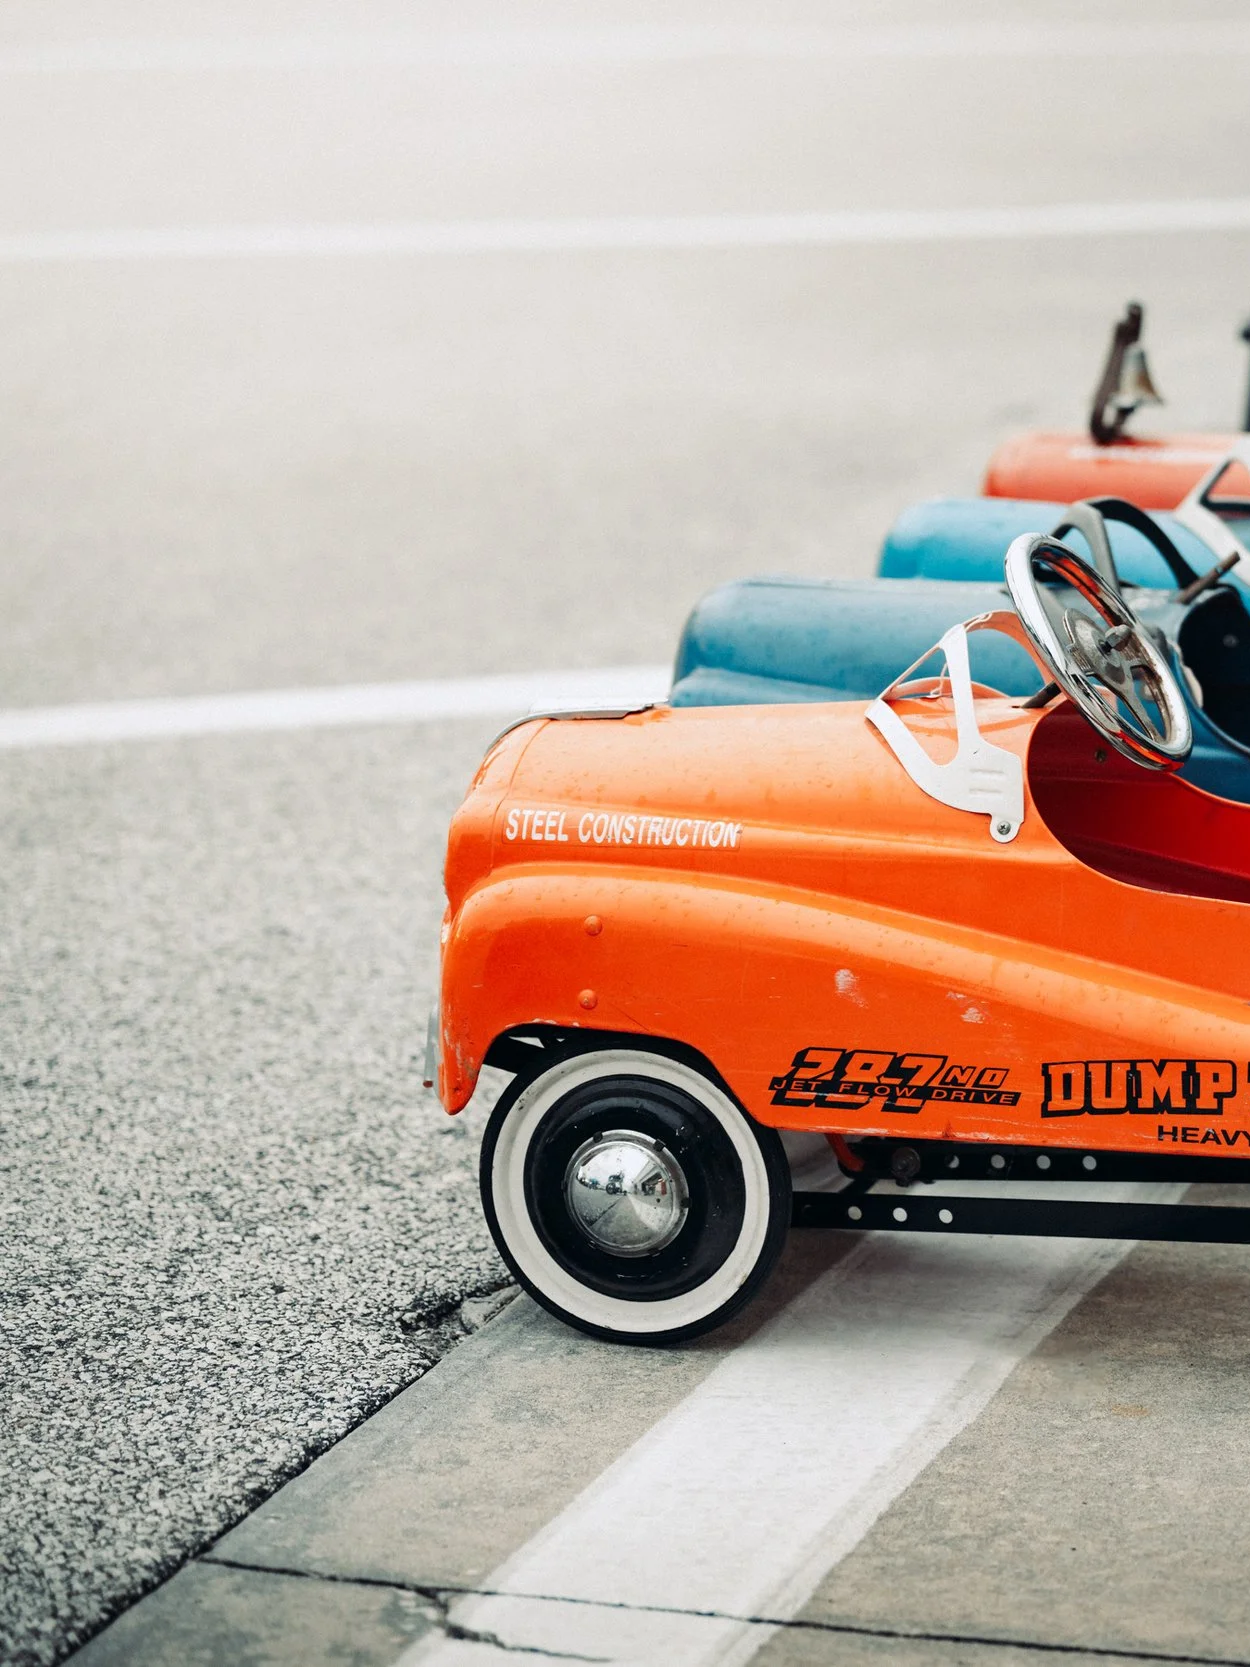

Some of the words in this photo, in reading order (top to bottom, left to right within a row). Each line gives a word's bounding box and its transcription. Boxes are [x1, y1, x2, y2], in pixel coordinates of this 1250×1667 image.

[505, 808, 569, 842] STEEL
[578, 812, 742, 848] CONSTRUCTION
[773, 1079, 822, 1093] JET
[839, 1082, 918, 1097] FLOW
[931, 1089, 1015, 1105] DRIVE
[1041, 1059, 1237, 1118] DUMP
